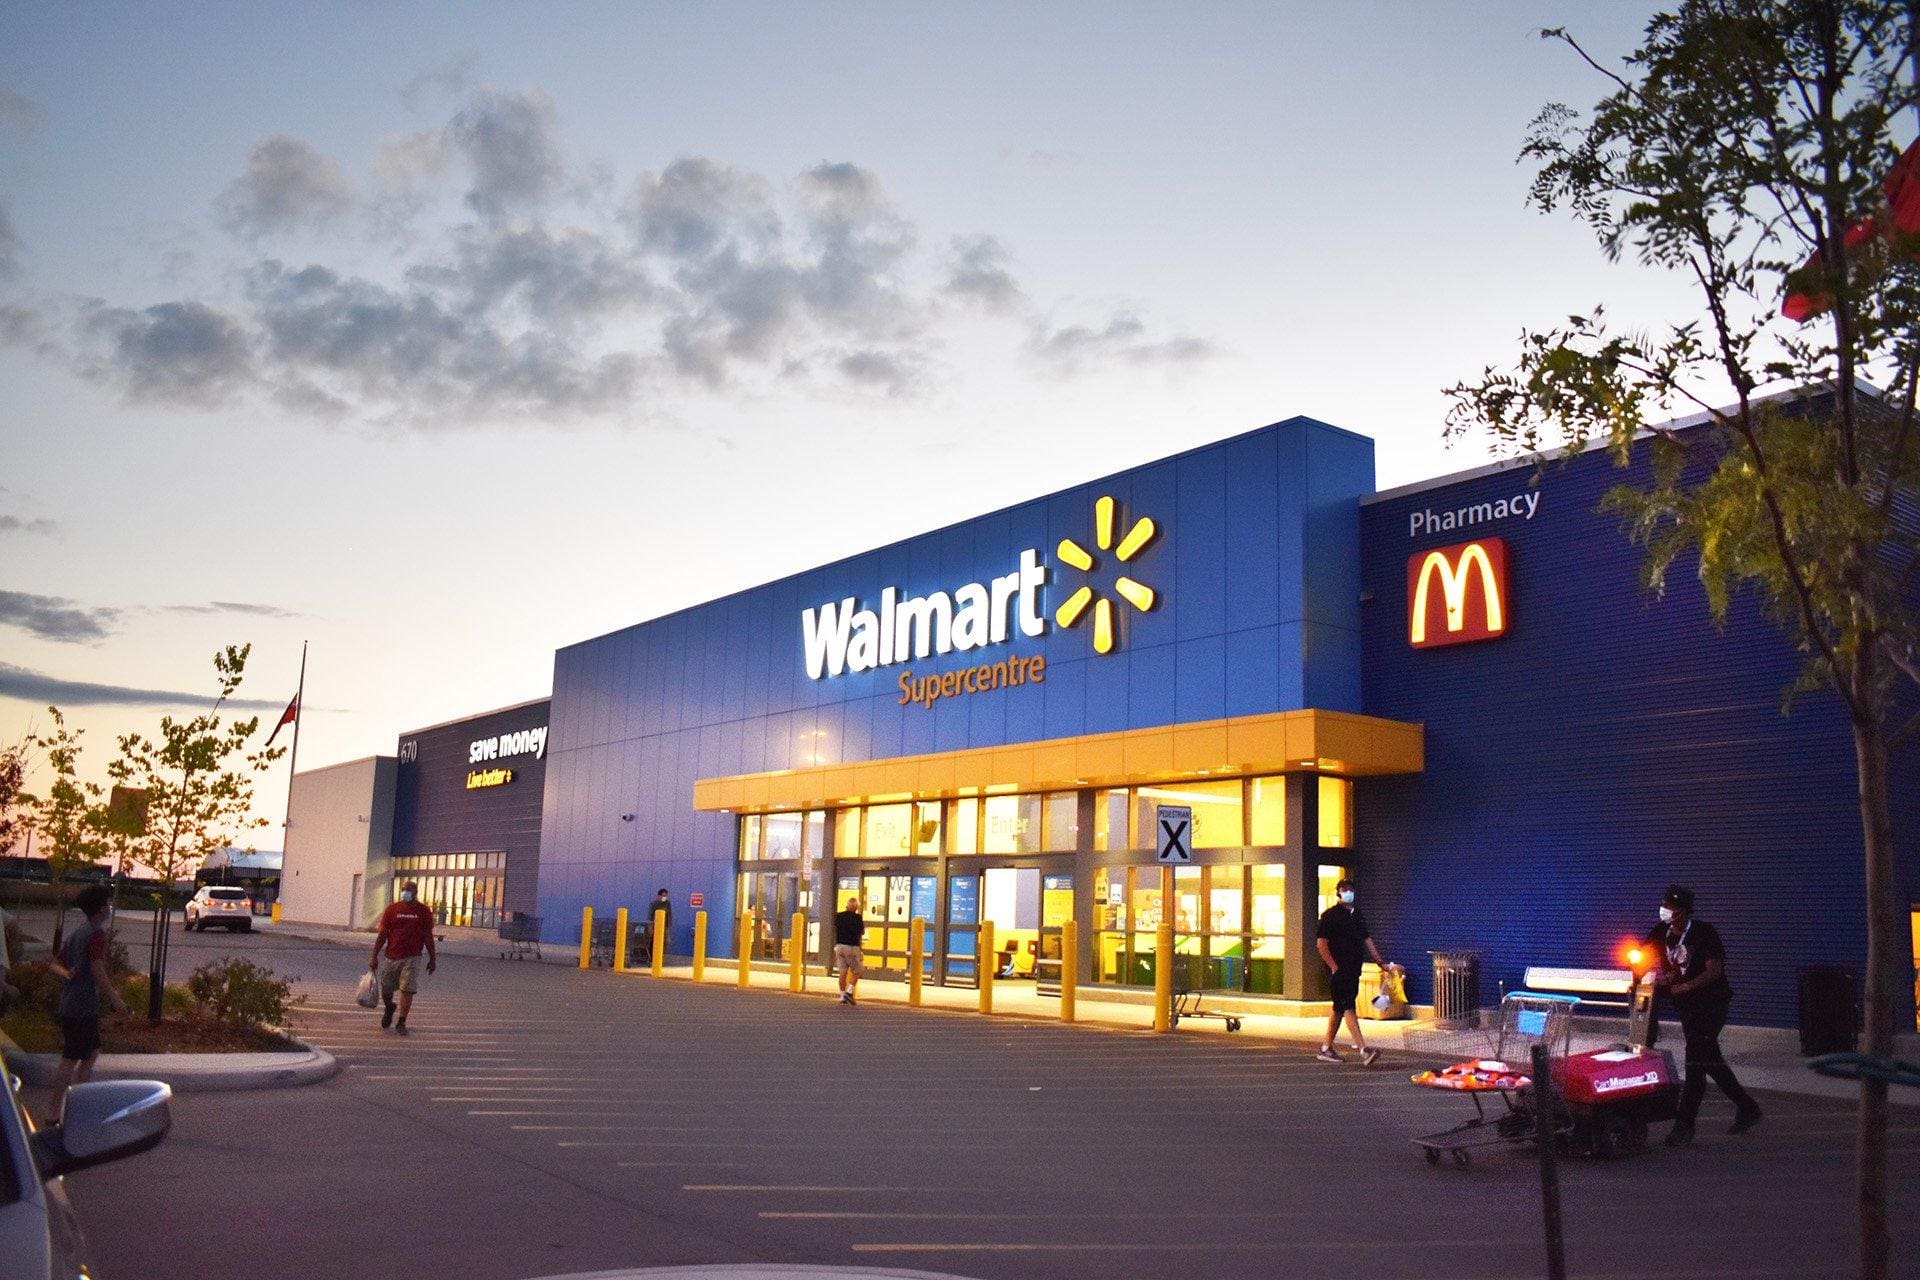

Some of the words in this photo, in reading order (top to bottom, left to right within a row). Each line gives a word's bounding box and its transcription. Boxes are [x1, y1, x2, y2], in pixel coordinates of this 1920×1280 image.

[1410, 491, 1540, 537] Pharmacy
[802, 548, 1046, 681] Walmart
[897, 653, 1046, 709] Supercentre
[400, 740, 418, 764] 670
[499, 726, 548, 760] money
[467, 771, 482, 789] Live
[482, 768, 506, 787] better
[991, 815, 1030, 834] Enter
[1160, 820, 1188, 859] X
